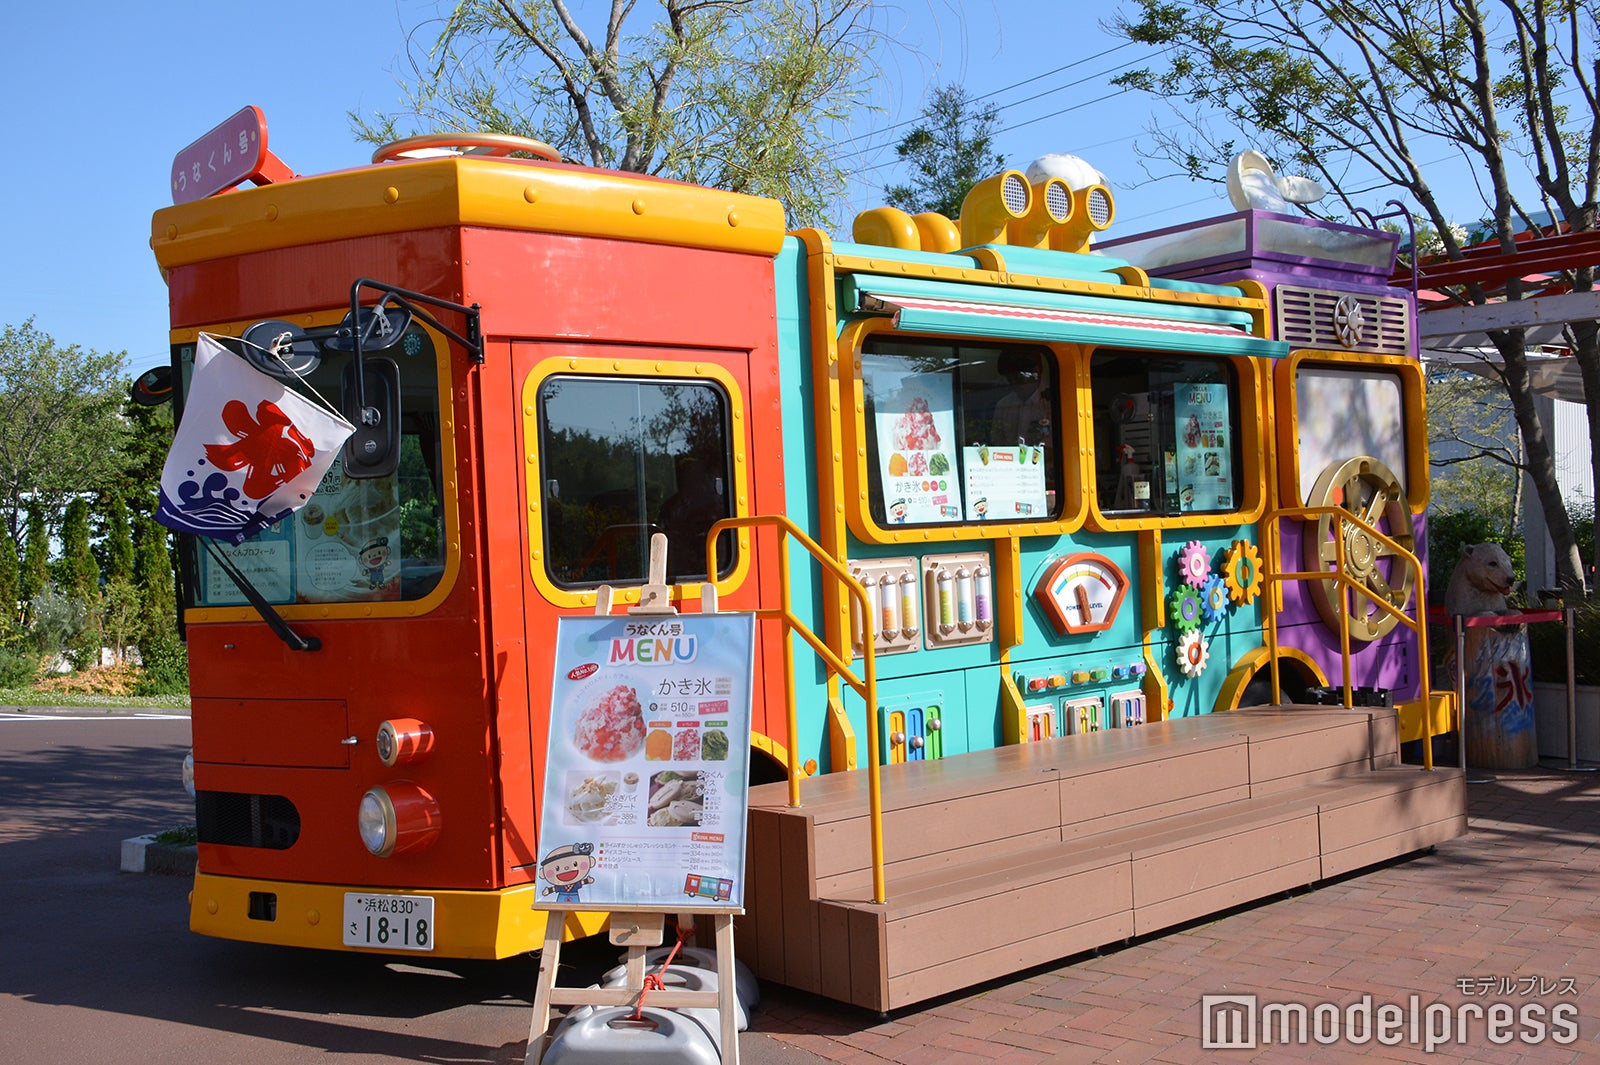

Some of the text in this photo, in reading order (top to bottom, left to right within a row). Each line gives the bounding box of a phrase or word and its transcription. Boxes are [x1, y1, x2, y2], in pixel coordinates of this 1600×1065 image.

[178, 129, 249, 192] うなくん号
[1189, 392, 1213, 404] MENU
[895, 480, 922, 493] かき氷
[224, 547, 276, 558] なくんプロフィール
[626, 623, 682, 637] うなくん号
[610, 637, 695, 663] MENU
[658, 677, 713, 696] かき氷
[1494, 660, 1533, 714] 氷
[670, 701, 696, 713] 510円
[364, 898, 414, 914] 浜松830
[350, 916, 428, 946] さ 18-18
